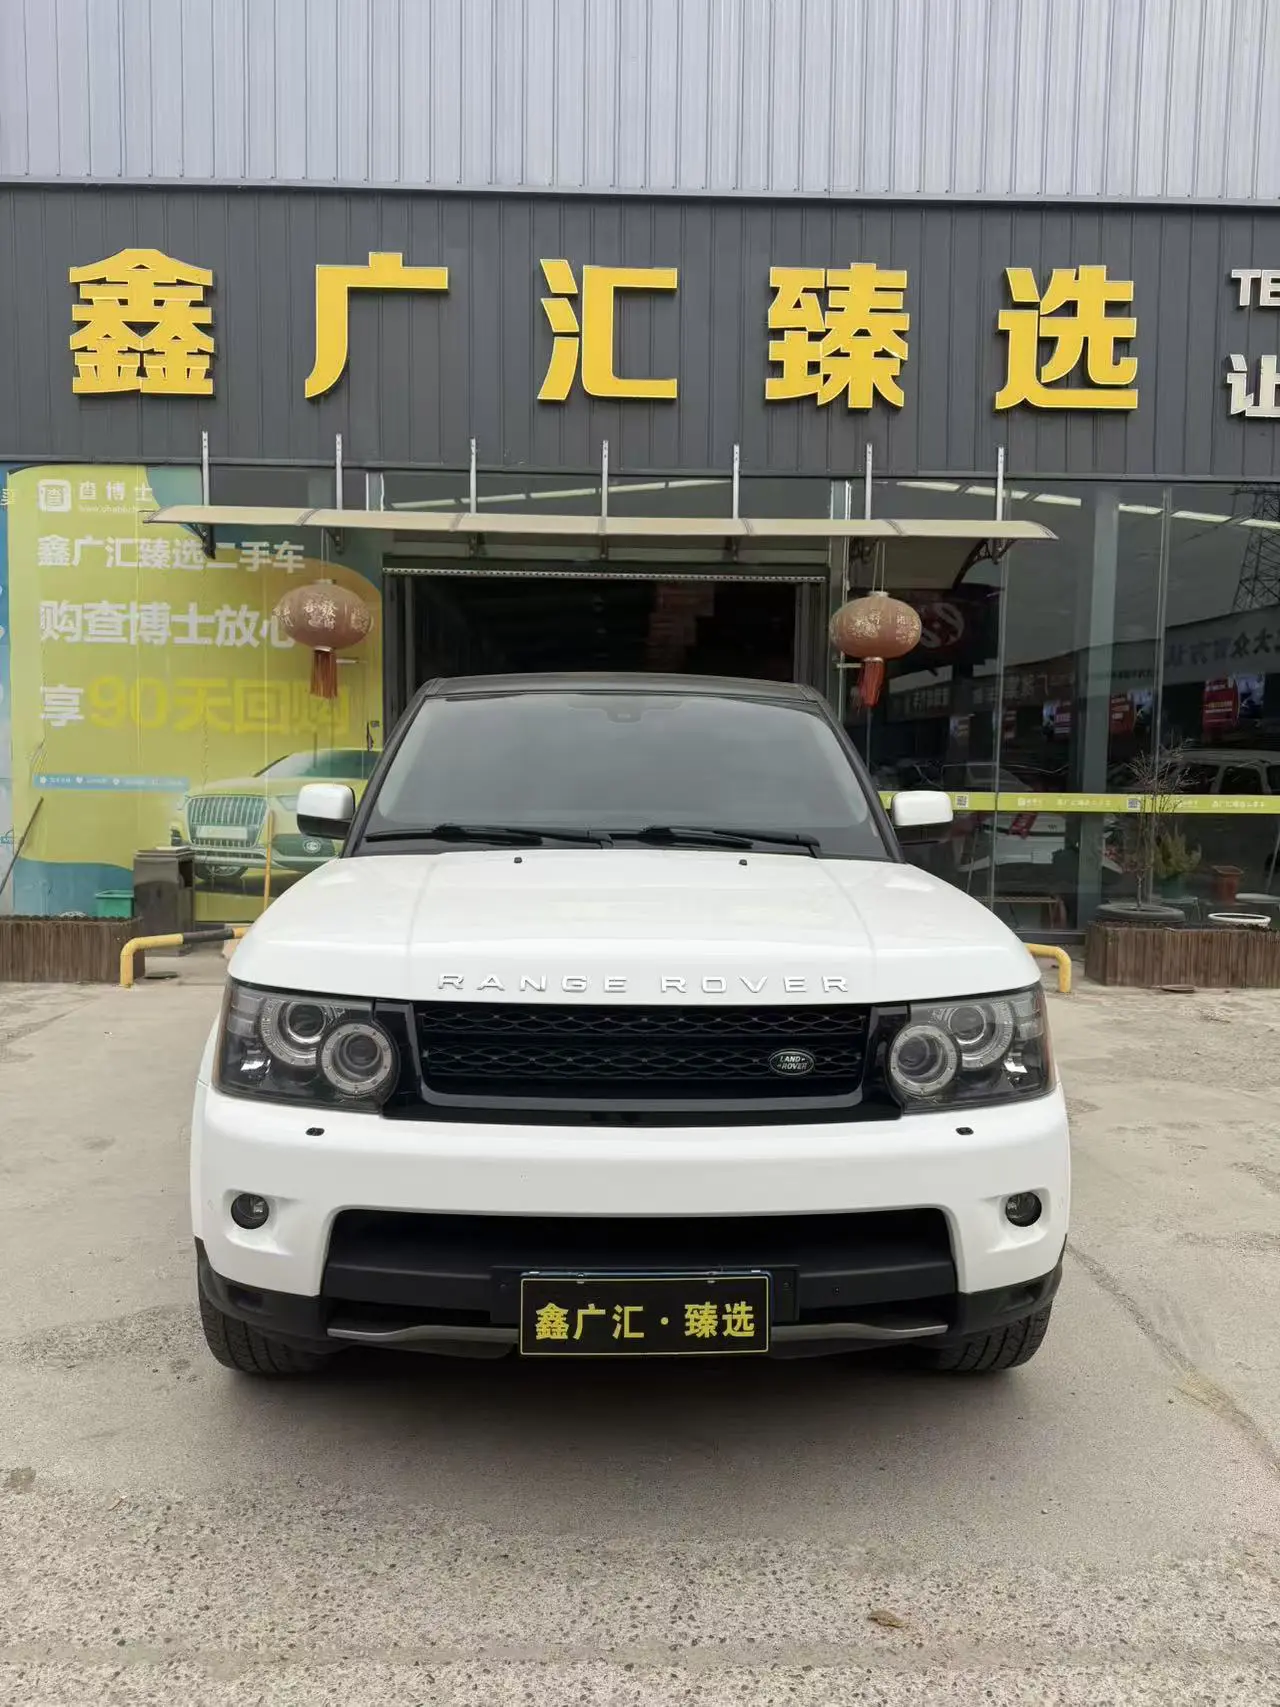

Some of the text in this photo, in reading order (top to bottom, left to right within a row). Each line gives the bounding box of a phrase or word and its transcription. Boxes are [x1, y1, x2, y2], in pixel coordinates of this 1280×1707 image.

[69, 248, 1139, 411] 鑫广汇臻选
[37, 534, 306, 573] 鑫广汇臻选二手车
[40, 600, 295, 648] 购查博士放心
[437, 973, 849, 993] RANGE ROVER
[779, 1055, 801, 1063] LAND
[781, 1062, 808, 1071] ROVER
